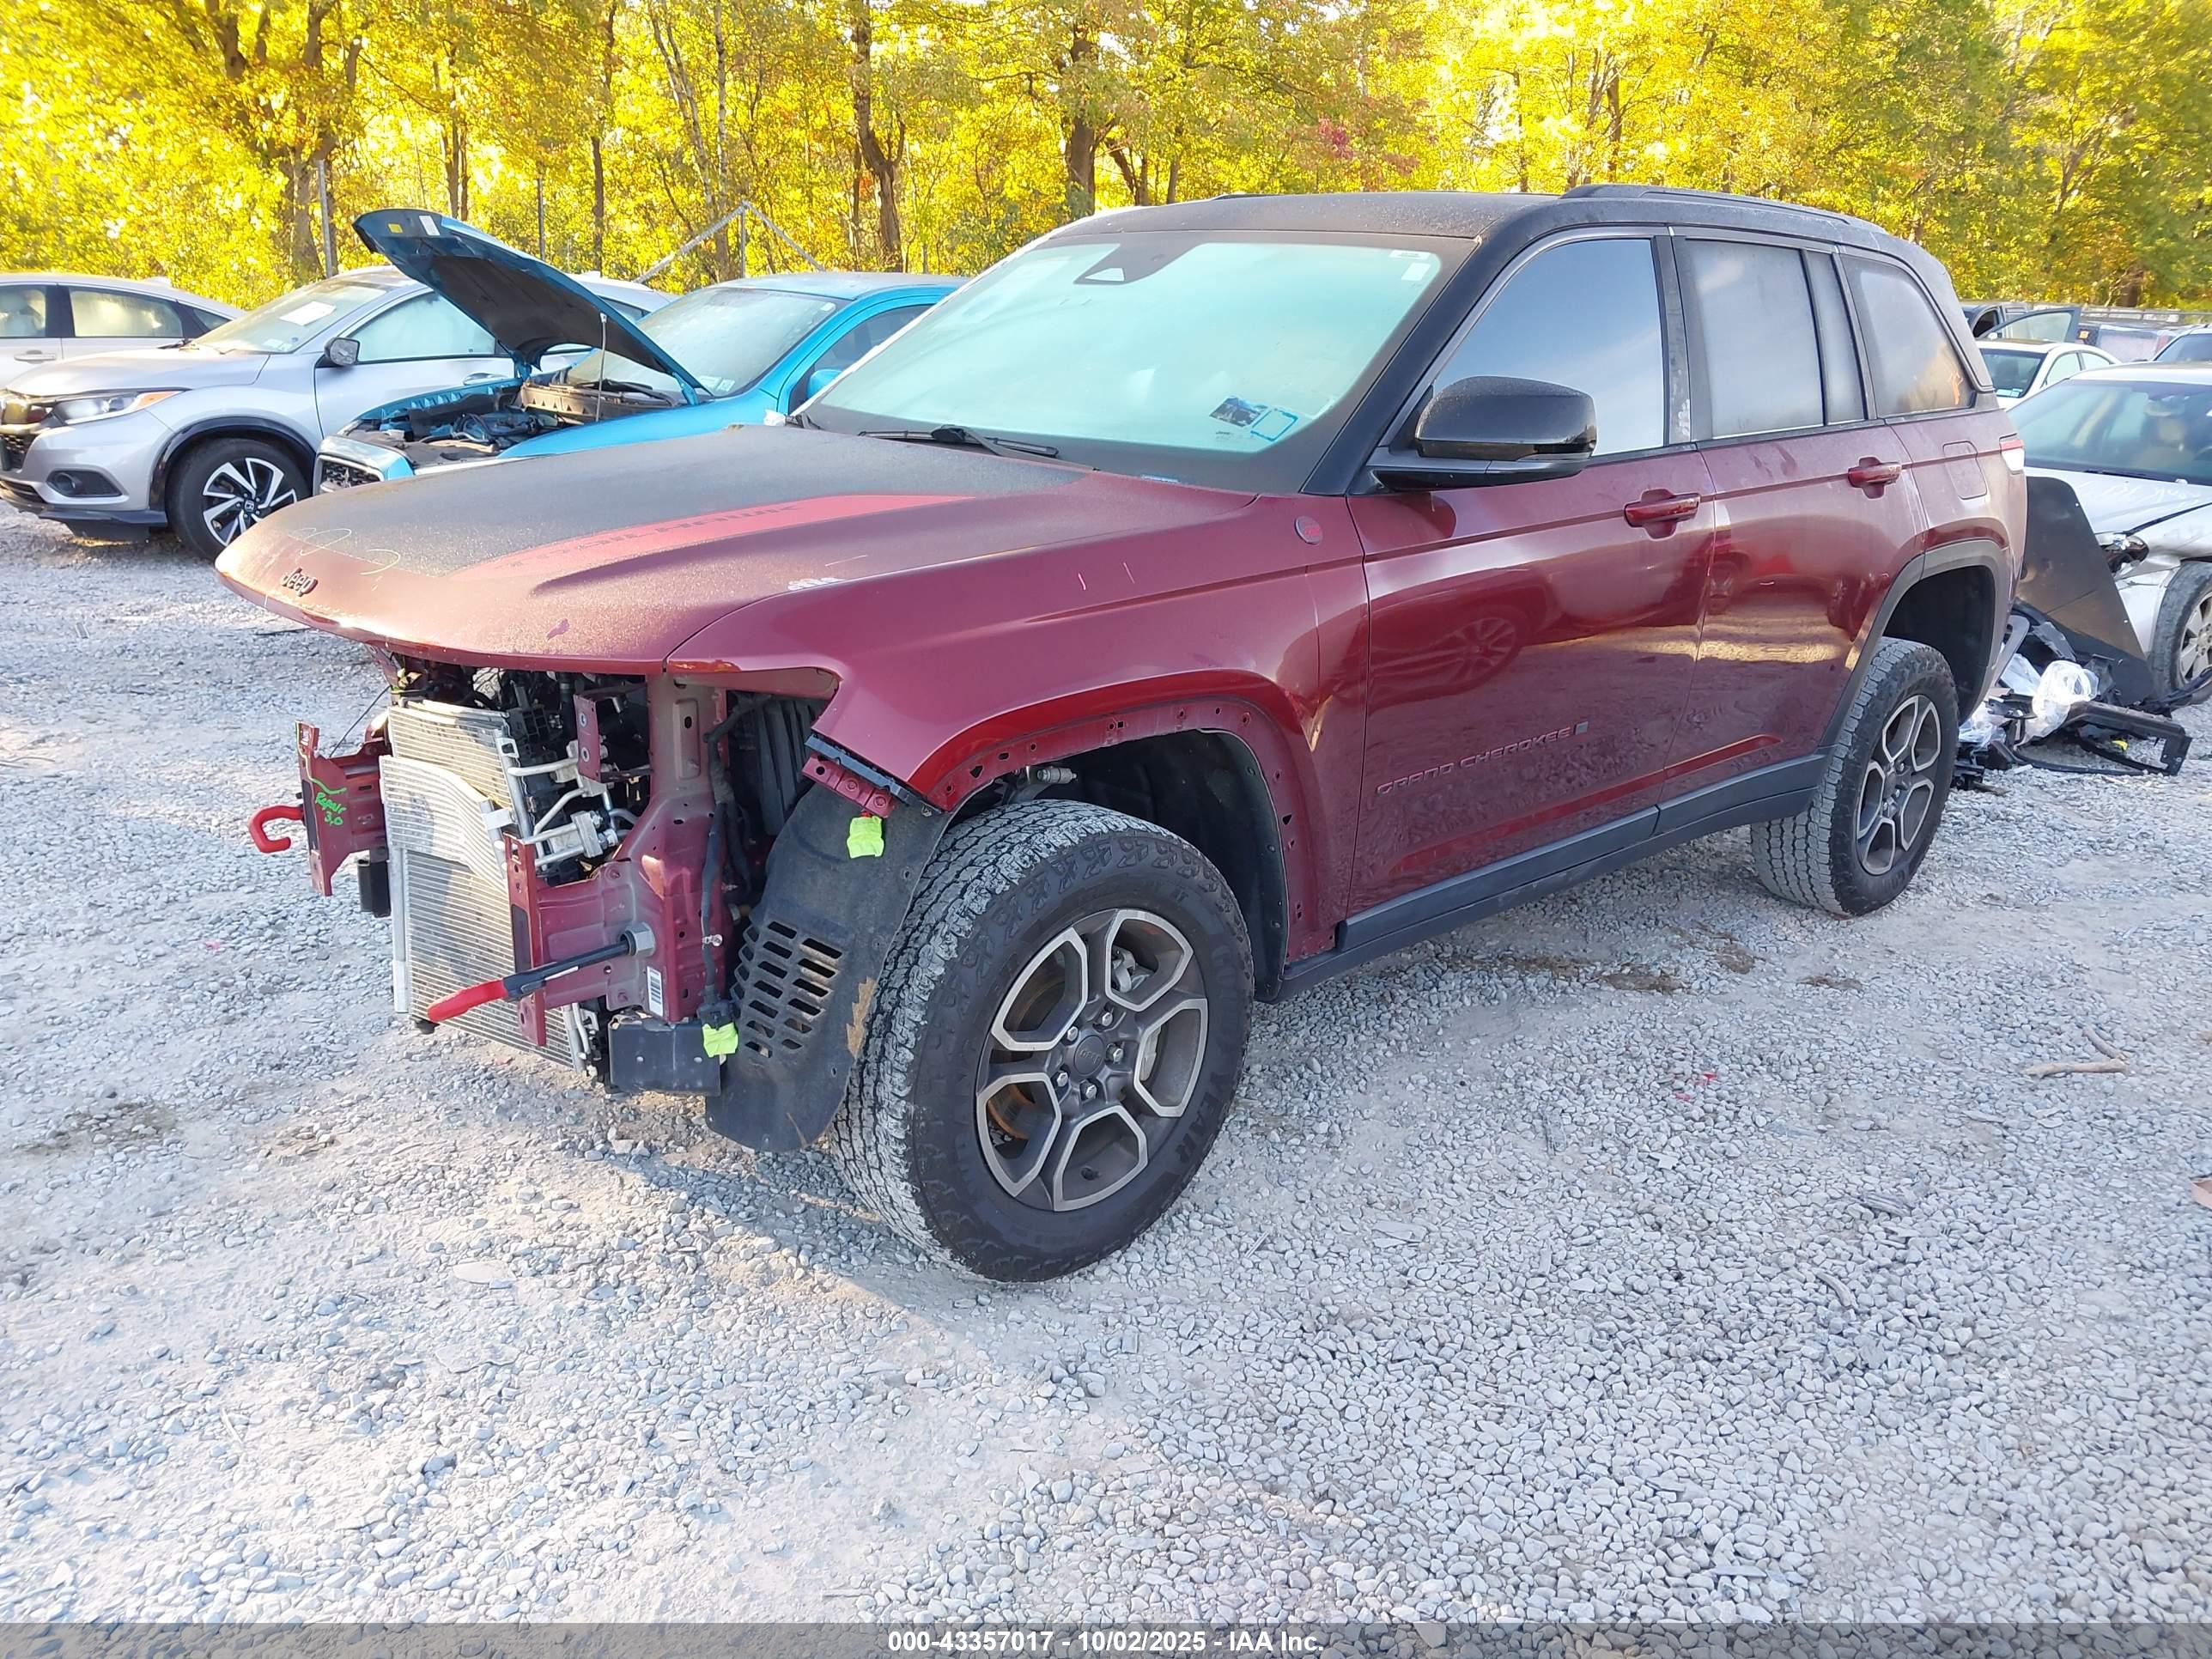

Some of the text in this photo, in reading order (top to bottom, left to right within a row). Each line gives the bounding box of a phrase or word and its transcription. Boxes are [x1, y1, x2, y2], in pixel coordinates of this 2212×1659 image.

[282, 568, 319, 597] Jeep
[1376, 727, 1571, 797] GRAND CHEROKEE
